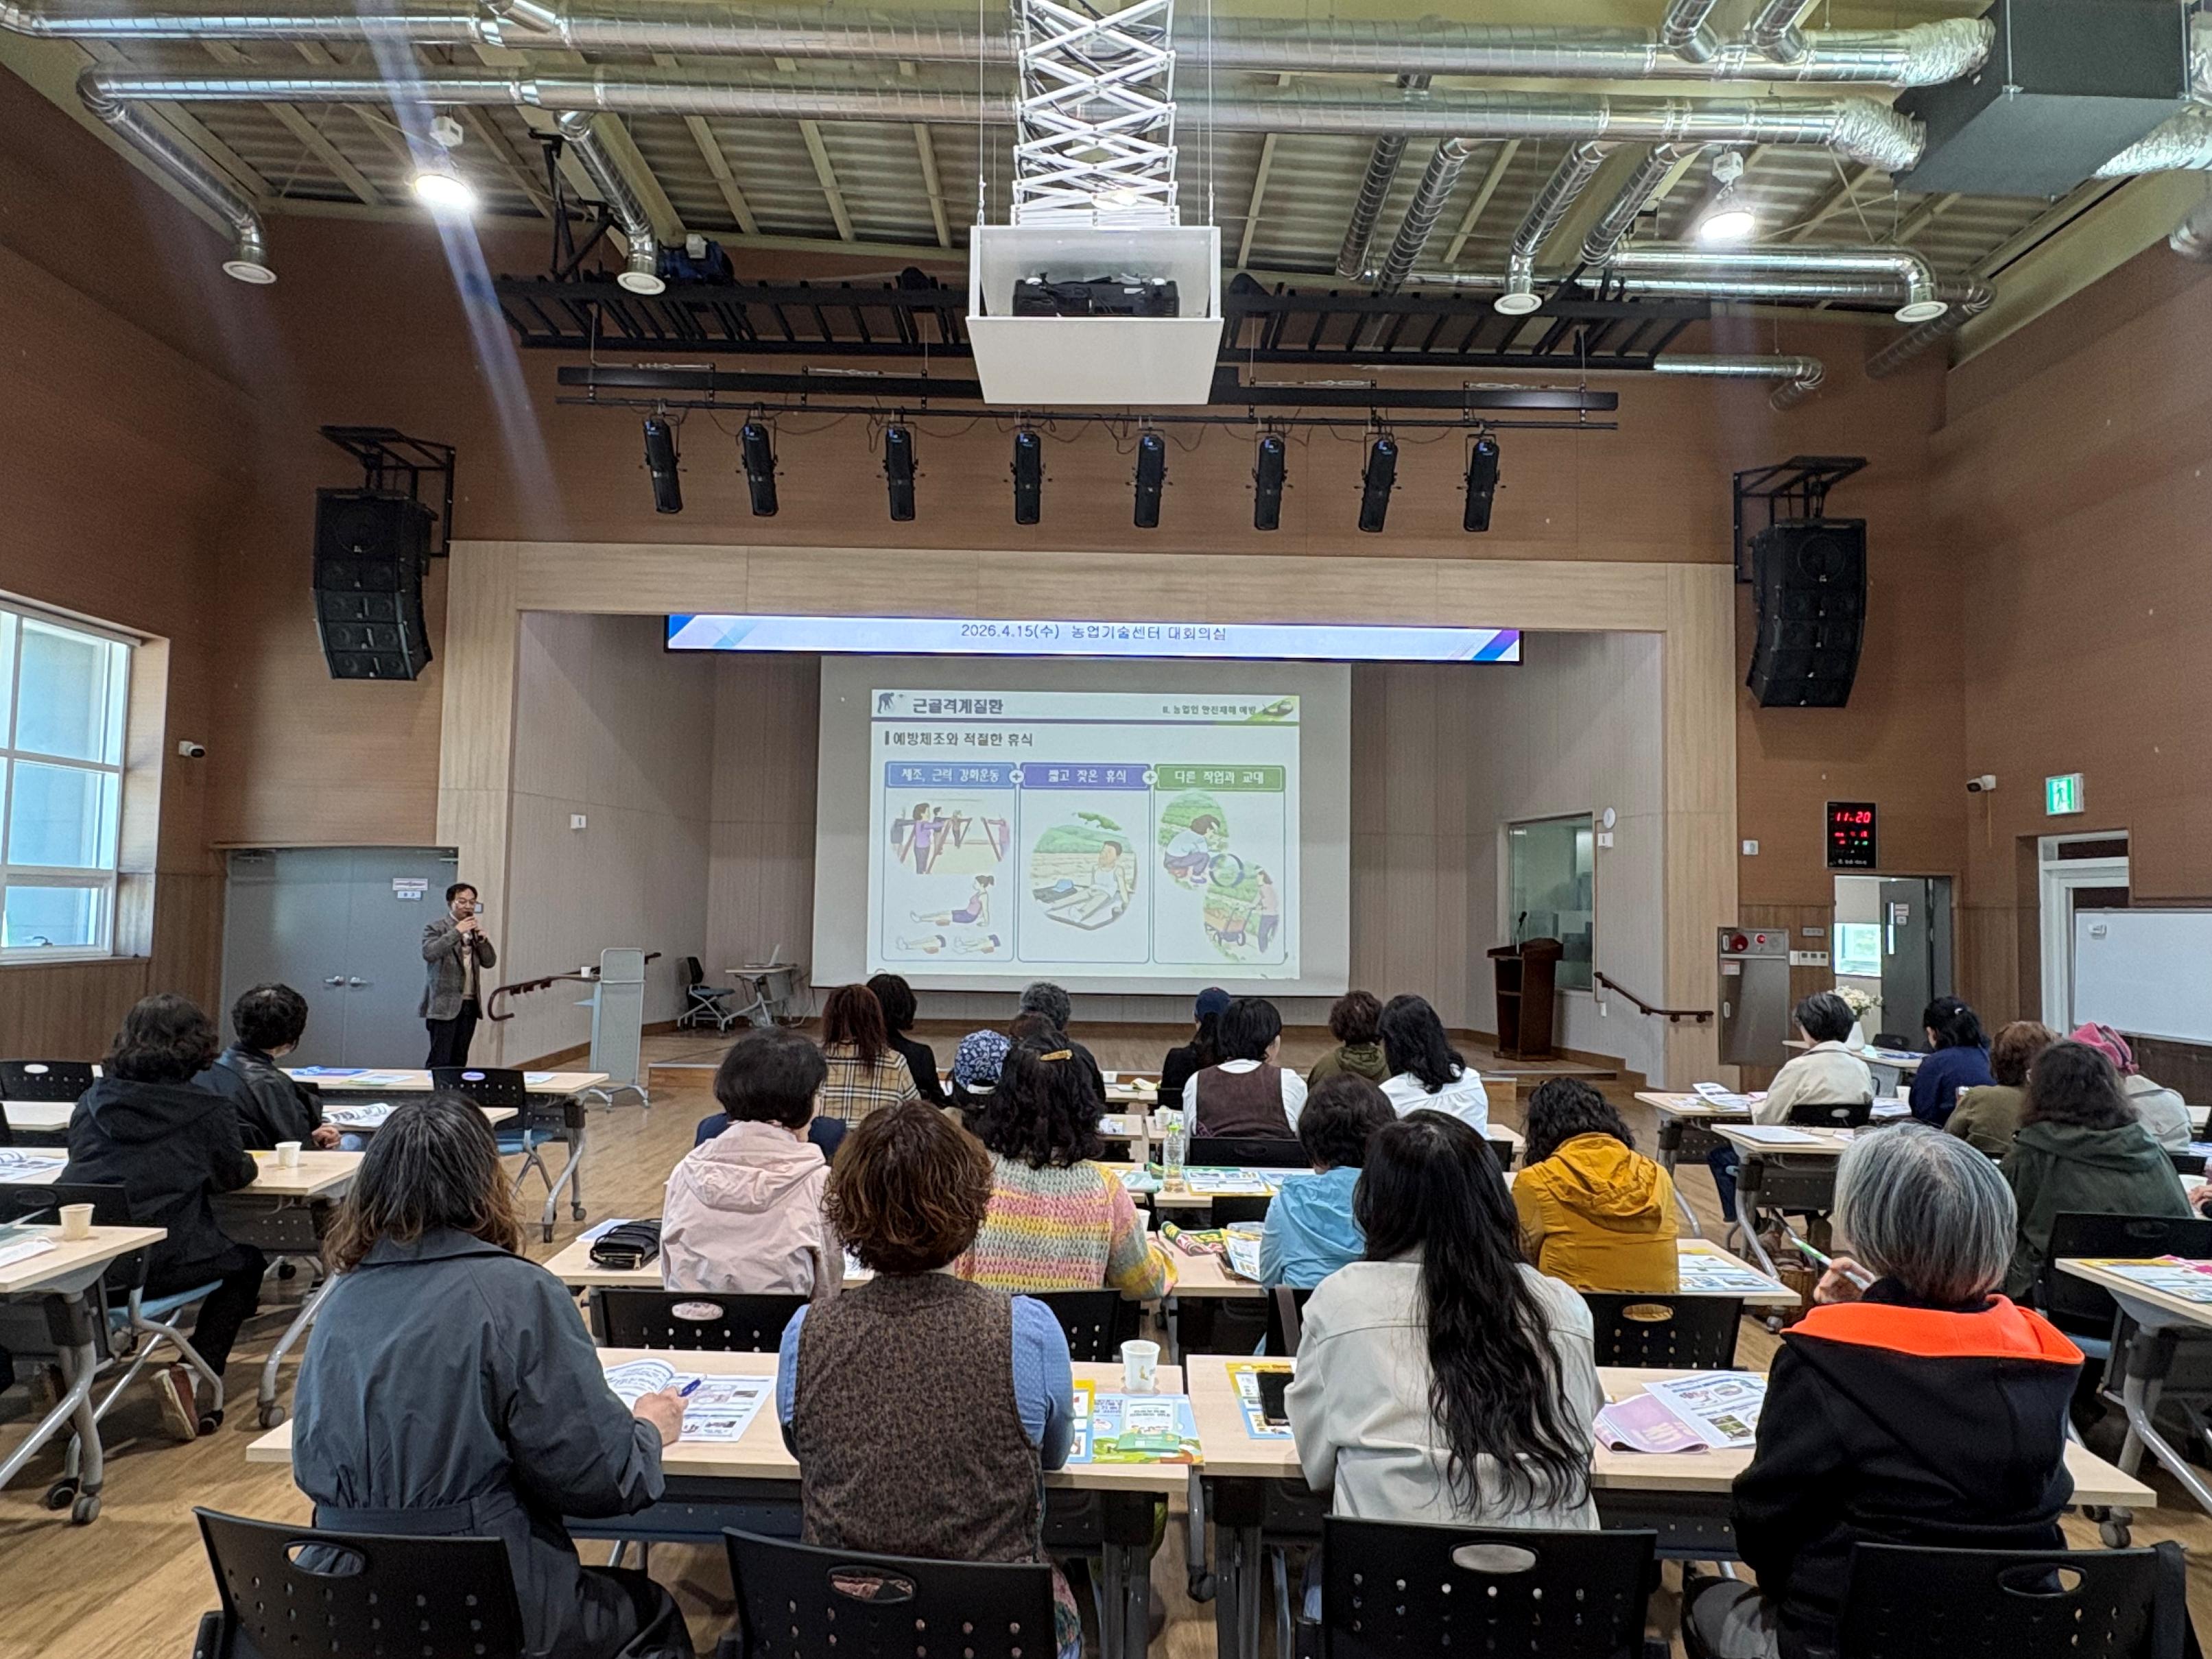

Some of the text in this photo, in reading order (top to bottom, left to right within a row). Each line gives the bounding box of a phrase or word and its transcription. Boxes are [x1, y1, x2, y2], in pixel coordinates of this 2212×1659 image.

[961, 624, 1226, 641] 2026.4.15(수) 농업기술센터 대회의실
[913, 698, 1003, 714] 근골격계질환
[1174, 705, 1198, 715] 농업인
[1239, 706, 1257, 715] 예방
[894, 732, 1033, 746] 예방체조와 적절한 휴식
[901, 768, 999, 783] 체조, 근력 강화운동
[1049, 769, 1127, 783] 짧고 잦은 휴식
[1174, 770, 1264, 785] 다른 작업과 교대
